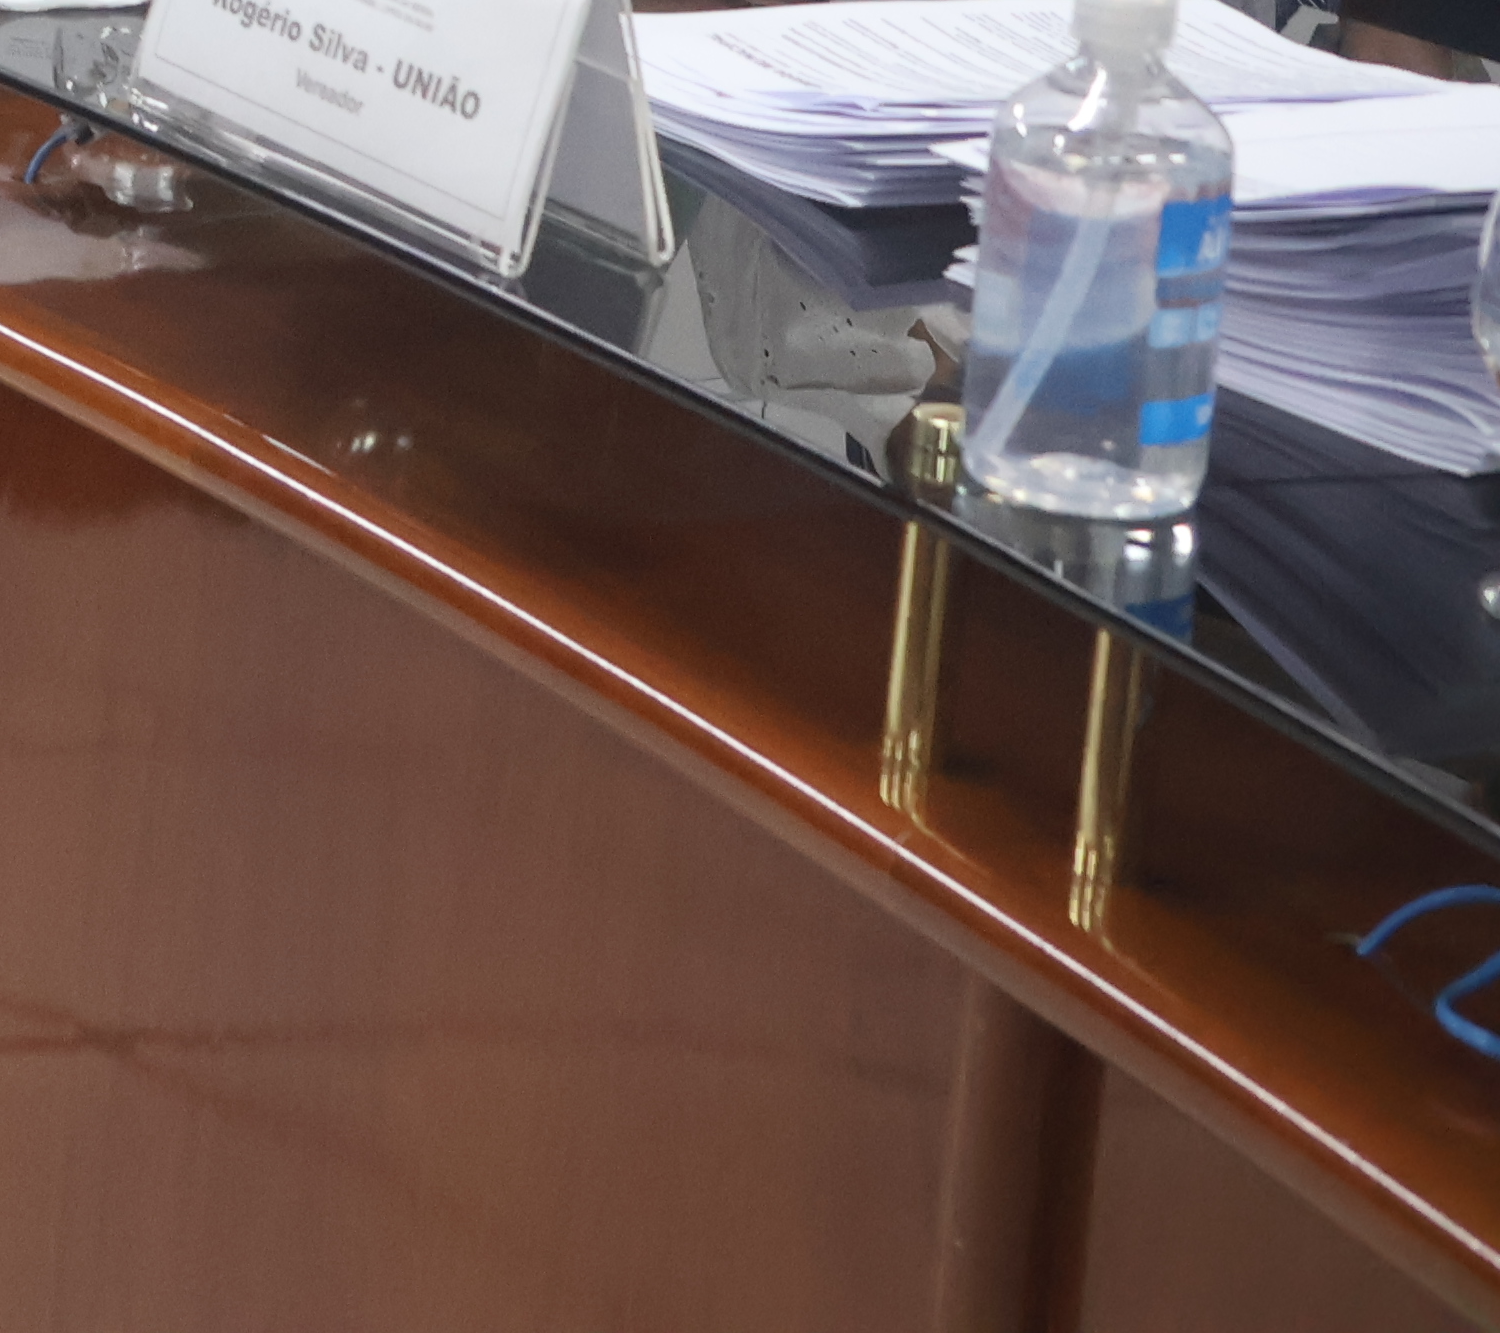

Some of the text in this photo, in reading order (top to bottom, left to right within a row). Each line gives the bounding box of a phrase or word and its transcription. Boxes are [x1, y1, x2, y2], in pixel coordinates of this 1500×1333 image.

[296, 67, 365, 116] Vereador
[309, 23, 369, 74] Silva
[393, 59, 481, 121] UNIÃO
